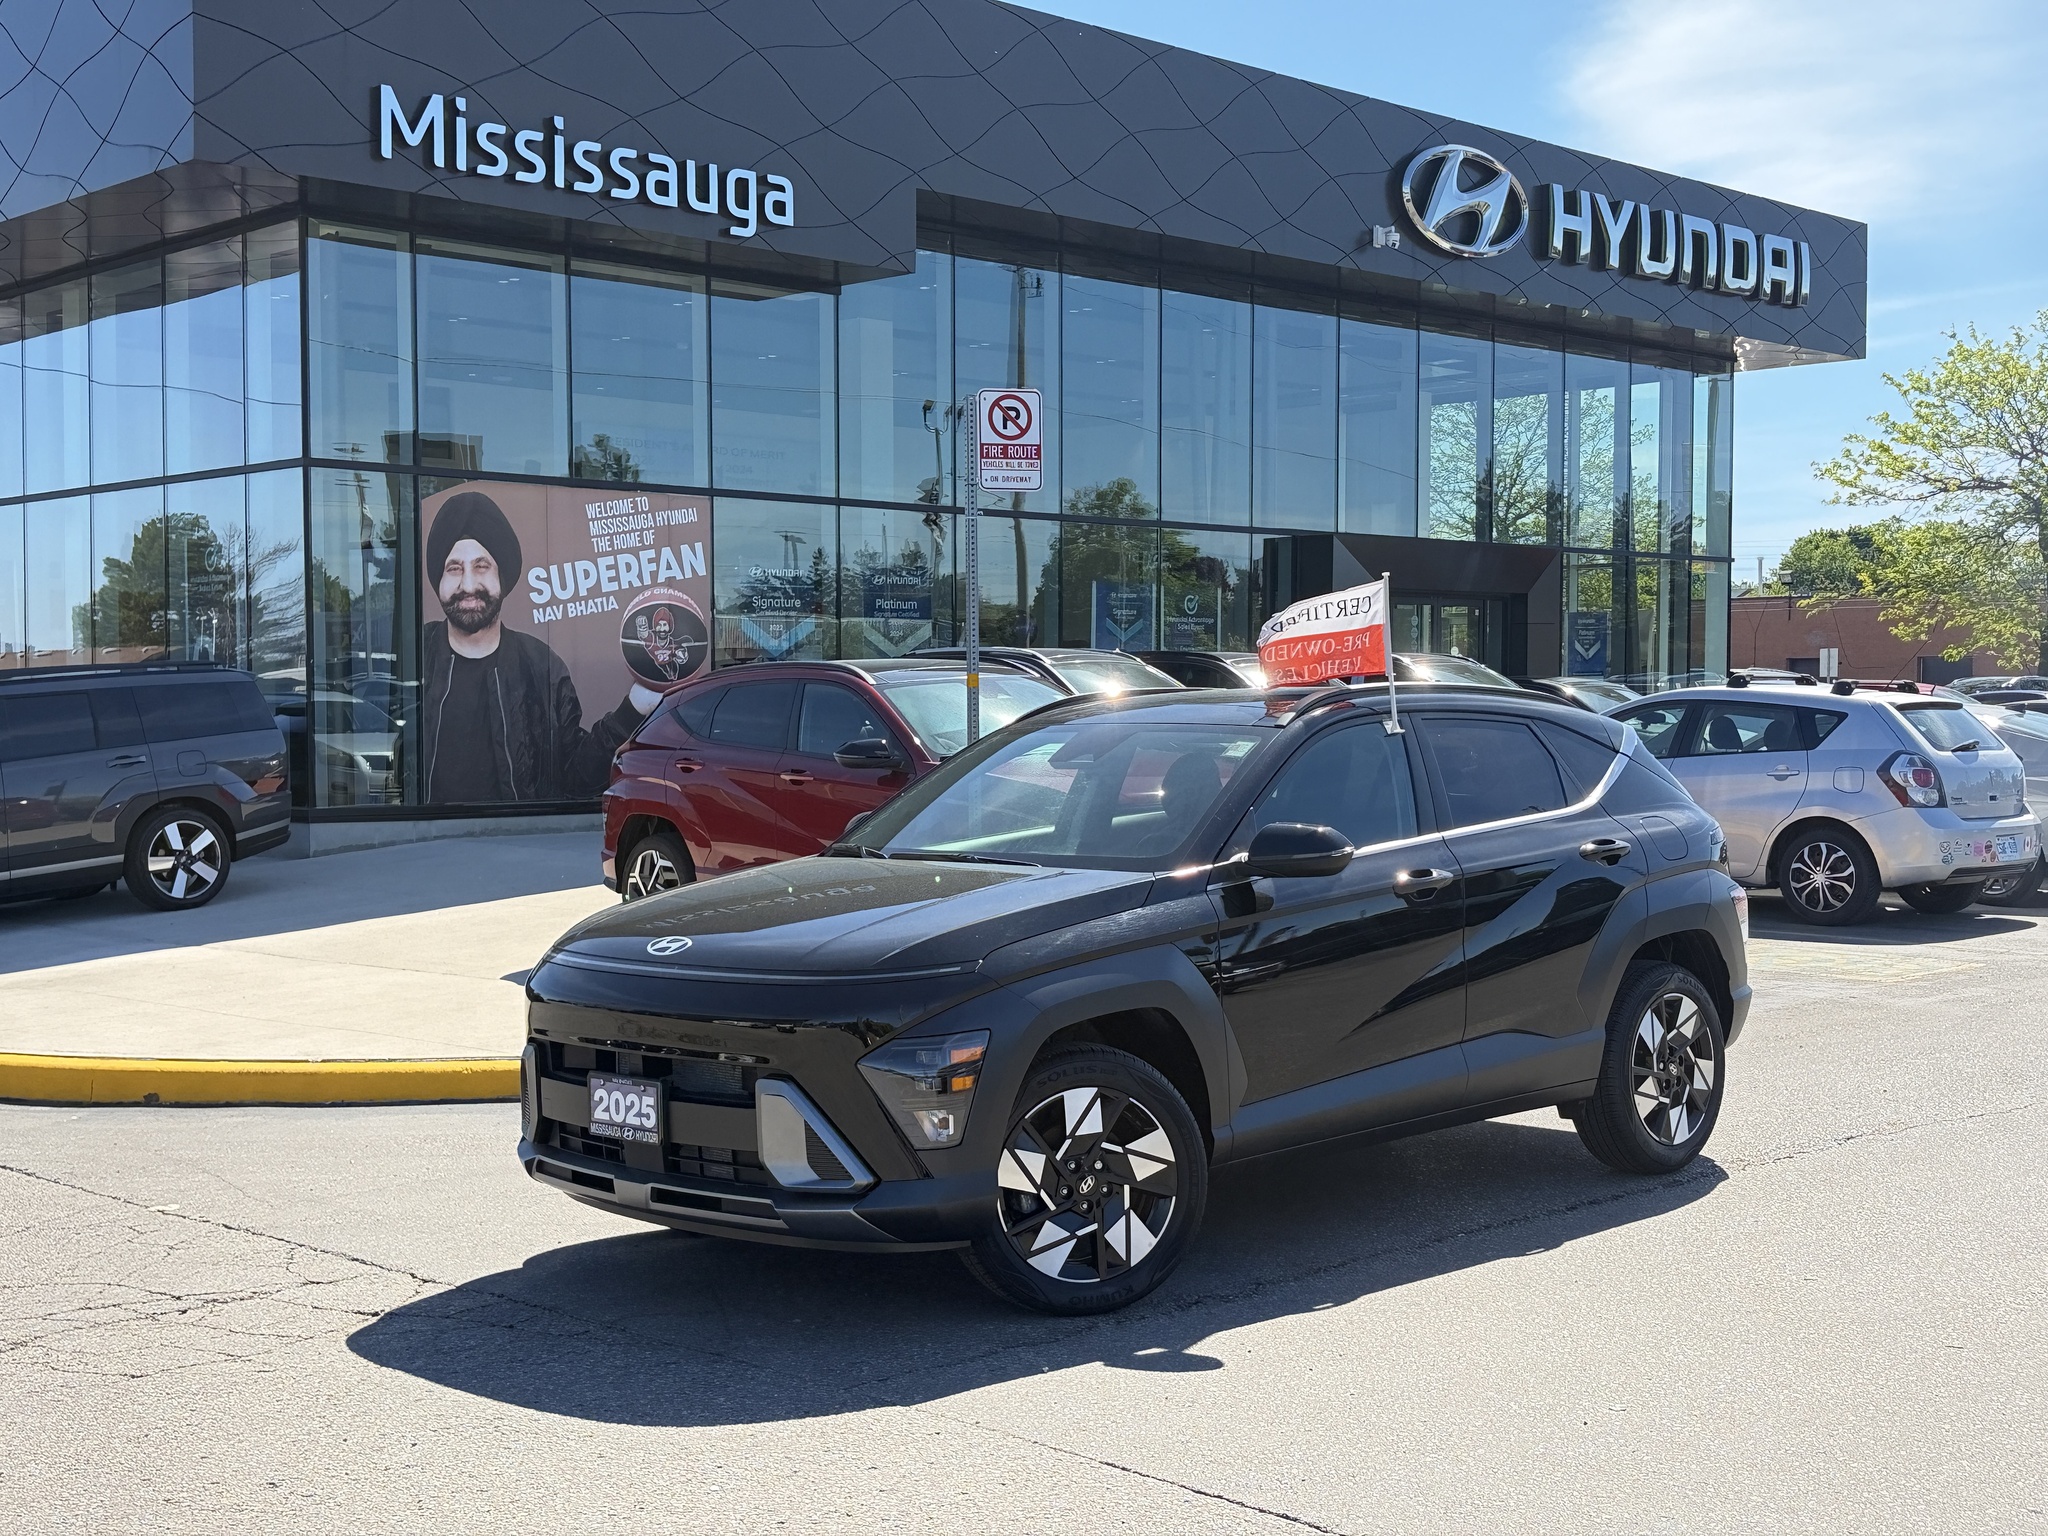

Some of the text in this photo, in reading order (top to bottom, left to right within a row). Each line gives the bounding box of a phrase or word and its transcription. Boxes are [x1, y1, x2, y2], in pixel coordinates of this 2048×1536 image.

[380, 83, 795, 238] Mississauga
[1549, 183, 1812, 307] HYUNDAI
[983, 445, 1038, 459] FIRE ROUTE
[1005, 461, 1015, 469] WILL
[1017, 461, 1023, 469] BE
[1025, 461, 1039, 469] TOWED
[990, 475, 1032, 483] ON DRIVEWAY
[585, 496, 649, 519] WELCOME TO
[589, 507, 698, 536] MISSISSAUGA HYUNDAI
[591, 530, 655, 553] THE HOME OF
[527, 541, 707, 604] SUPERFAN
[887, 576, 921, 585] HYUNDAI
[532, 596, 619, 624] NAV BHATIA
[752, 596, 801, 609] Signature
[875, 598, 918, 609] Platinum
[1036, 1065, 1098, 1089] SOLUS
[593, 1088, 656, 1129] 2025
